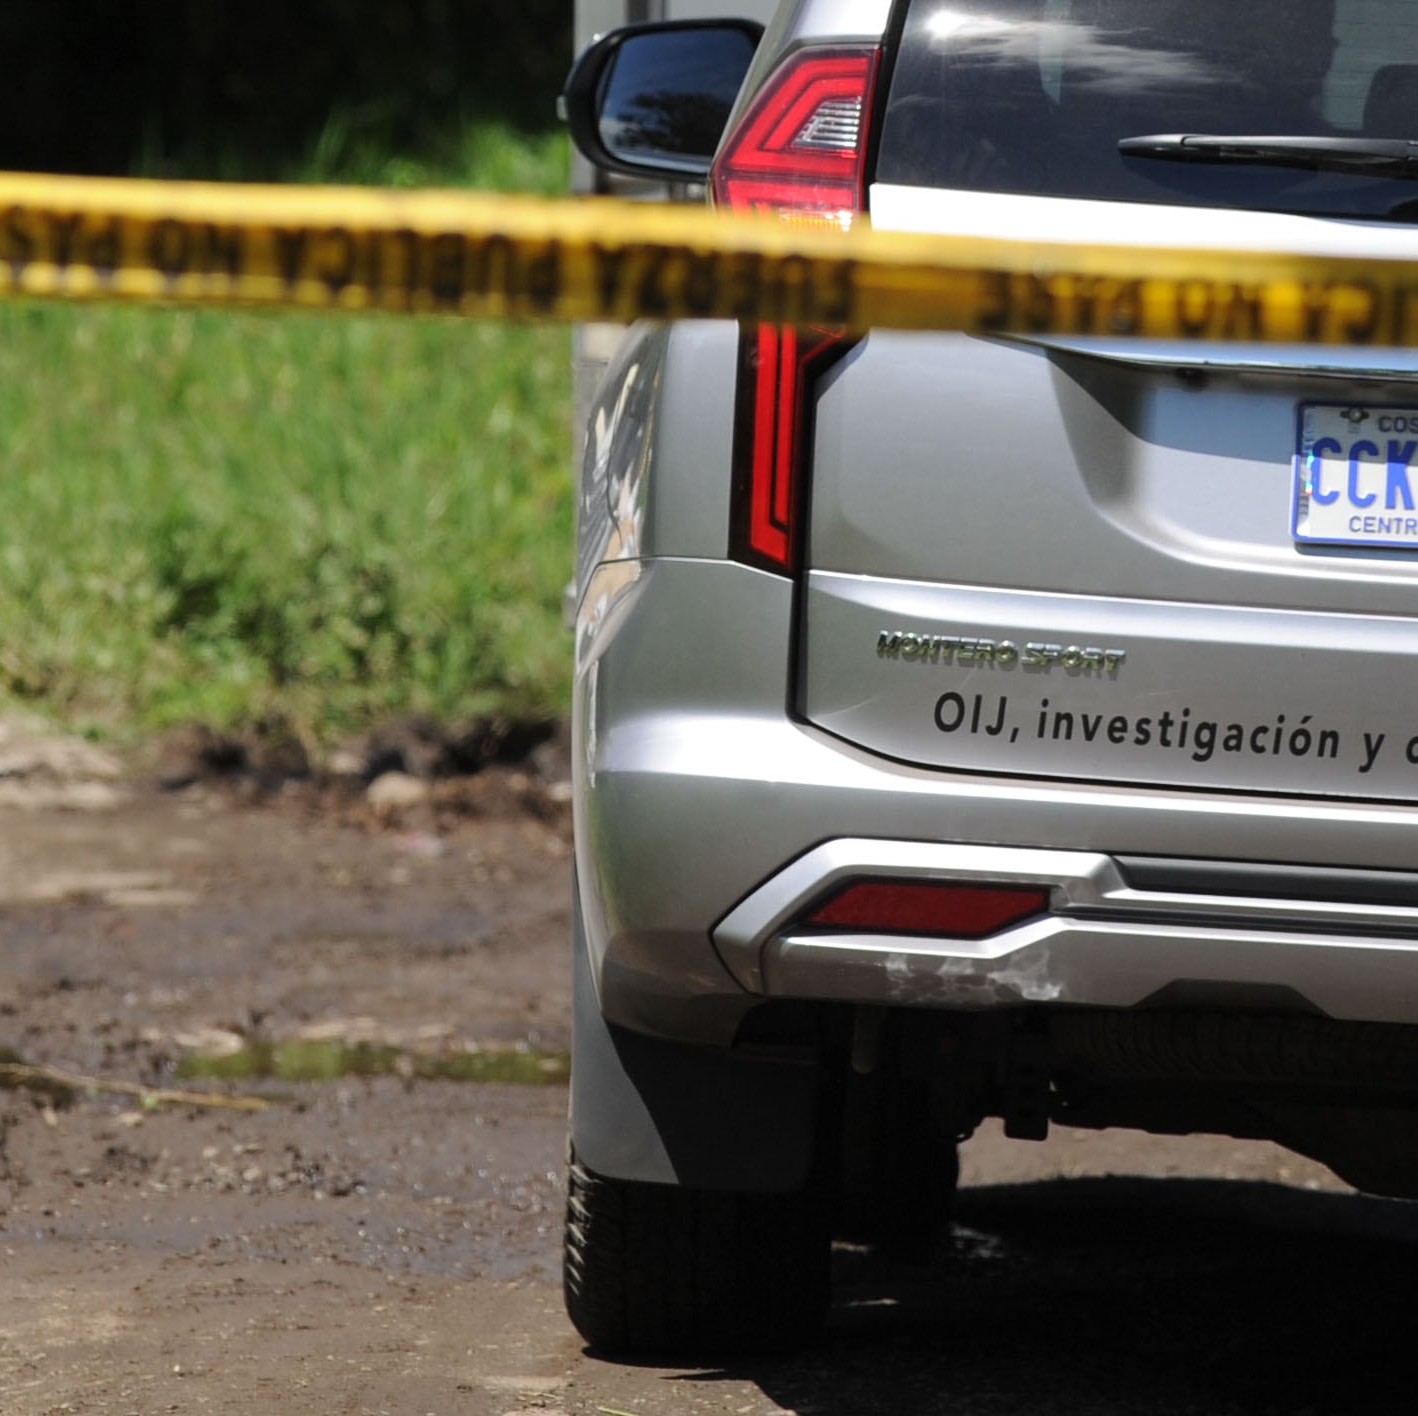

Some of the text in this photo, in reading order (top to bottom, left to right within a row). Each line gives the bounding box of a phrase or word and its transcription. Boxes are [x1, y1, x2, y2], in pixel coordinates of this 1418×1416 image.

[876, 629, 1127, 672] MONTERO SPORT
[933, 691, 1020, 743] OIJ,
[1037, 698, 1341, 763] investigación
[1357, 732, 1386, 774] y
